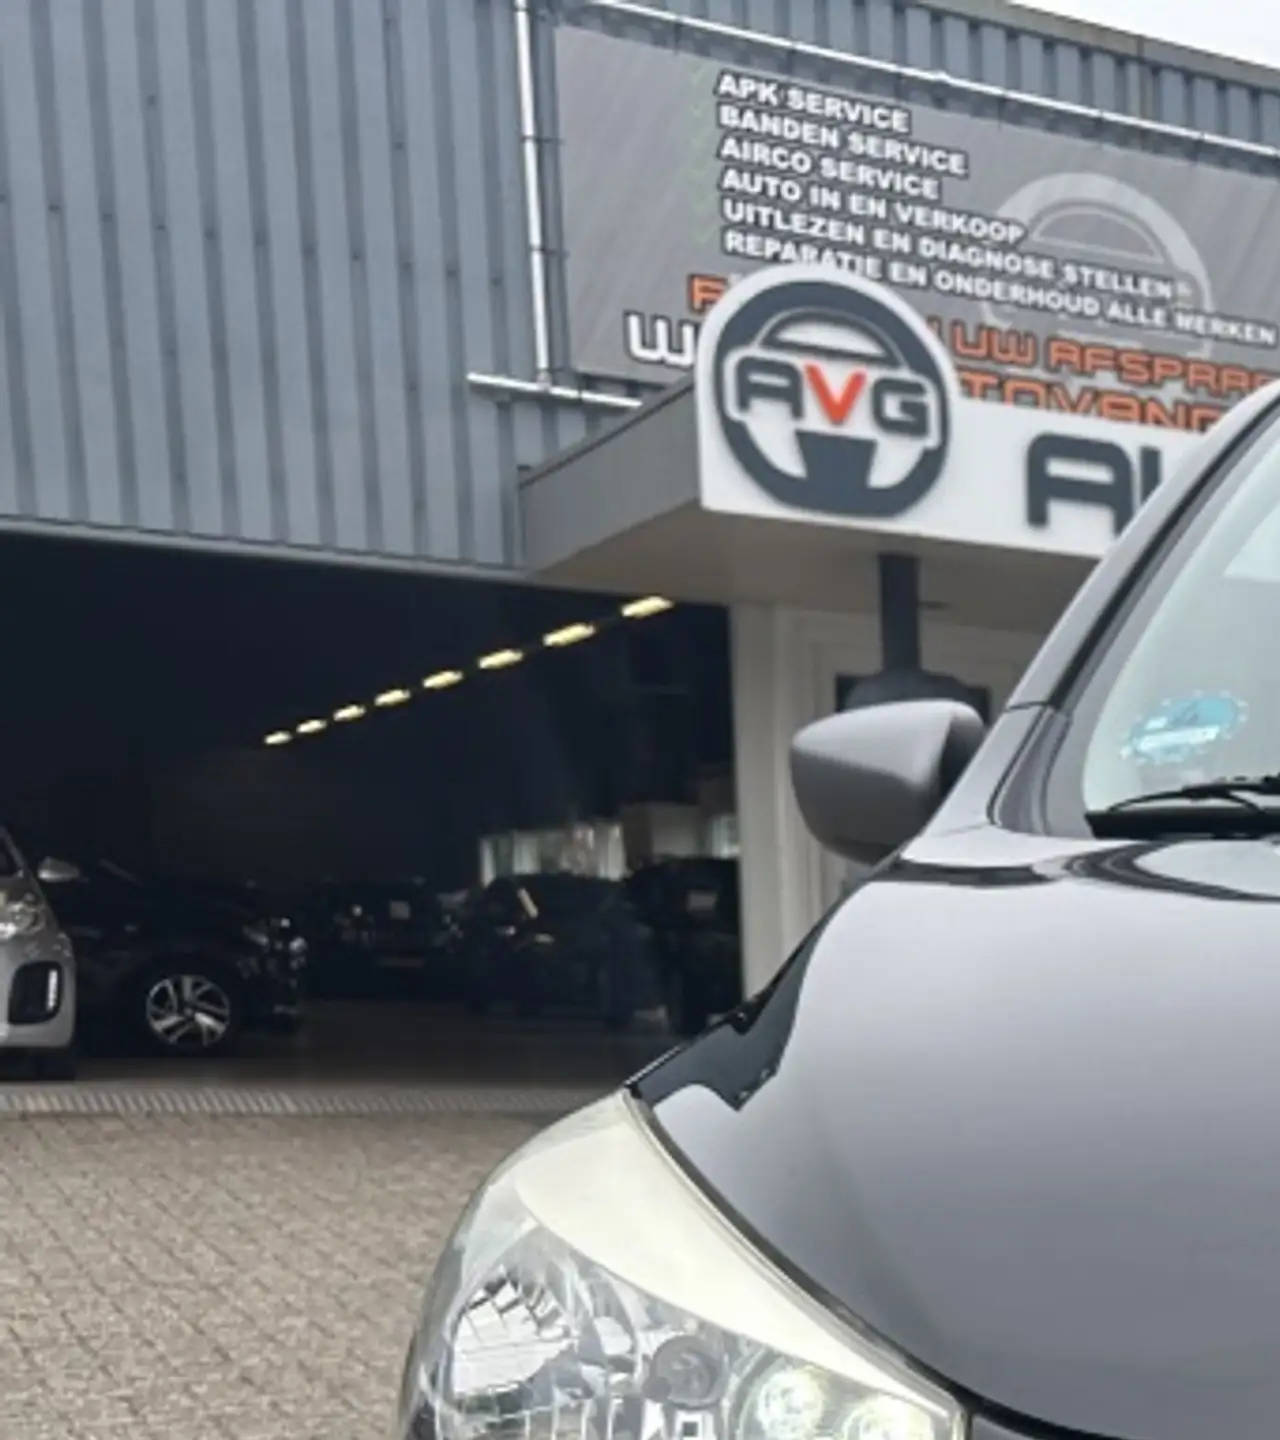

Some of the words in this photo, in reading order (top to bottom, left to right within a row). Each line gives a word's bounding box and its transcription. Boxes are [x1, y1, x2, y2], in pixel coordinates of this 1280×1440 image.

[718, 74, 778, 104] APK
[787, 88, 910, 133] SERVICE
[719, 105, 840, 149] BANDEN
[848, 133, 967, 175] SERVICE
[720, 138, 812, 173] AIRCO
[820, 157, 940, 200] SERVICE
[722, 169, 802, 202] AUTO
[809, 188, 841, 211] IN
[850, 196, 887, 219] EN
[894, 202, 1025, 244] VERKOOP
[722, 200, 865, 245] UITLEZEN
[873, 229, 911, 254] EN
[919, 237, 1055, 280] DIAGNOSE
[1062, 263, 1173, 300] STELLEN
[890, 262, 927, 286] EN
[934, 270, 1100, 316] ONDERHOUD
[1105, 302, 1167, 326] ALLE
[1174, 313, 1275, 345] WERKEN
[736, 357, 930, 438] AVG
